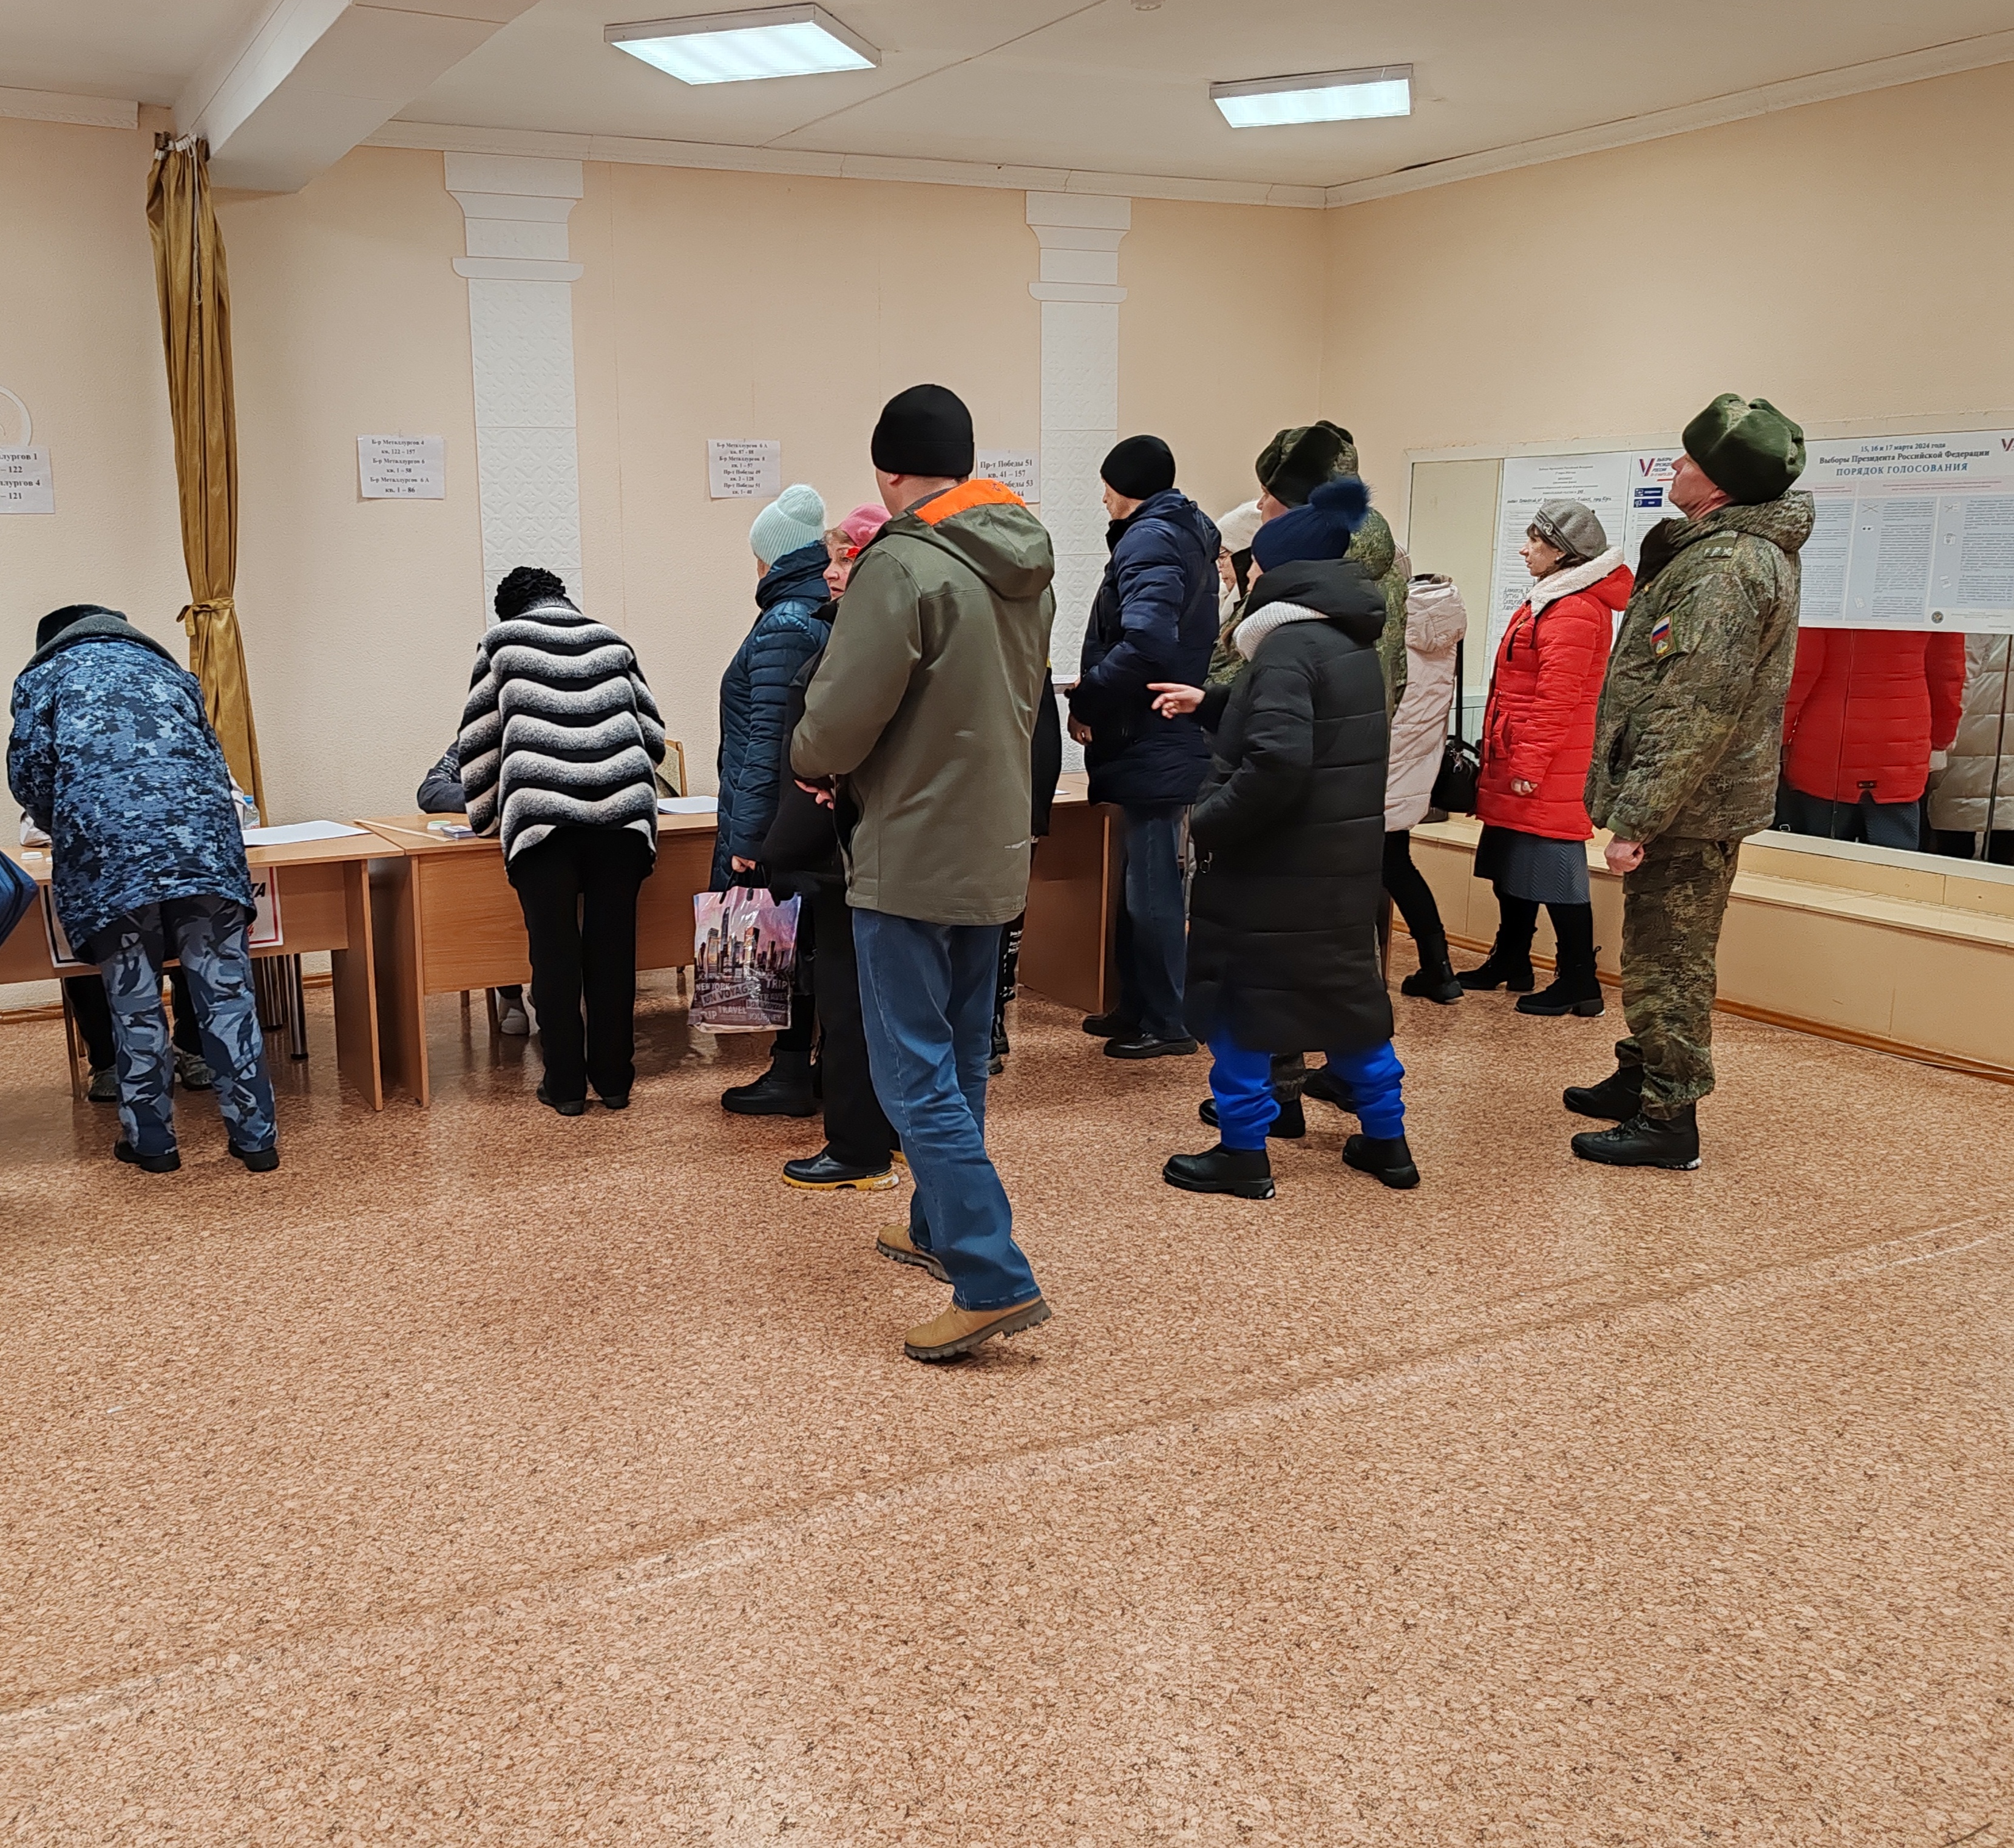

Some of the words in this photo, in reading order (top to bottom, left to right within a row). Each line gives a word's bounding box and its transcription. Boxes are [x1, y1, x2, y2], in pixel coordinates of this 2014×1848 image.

[1819, 457, 1850, 465] Выборы
[1851, 455, 1895, 464] Президента
[1898, 452, 1942, 460] Российской
[1945, 450, 1990, 459] Федерации
[980, 461, 996, 470] Пр-т
[1836, 467, 1884, 476] ПОРЯДОК
[1887, 463, 1968, 474] ГОЛОСОВАНИЯ
[696, 983, 710, 991] NEW
[711, 983, 731, 991] YORK
[765, 977, 788, 990] TRIP
[718, 983, 754, 1000] VOYAG
[717, 1006, 747, 1014] TRAVEL
